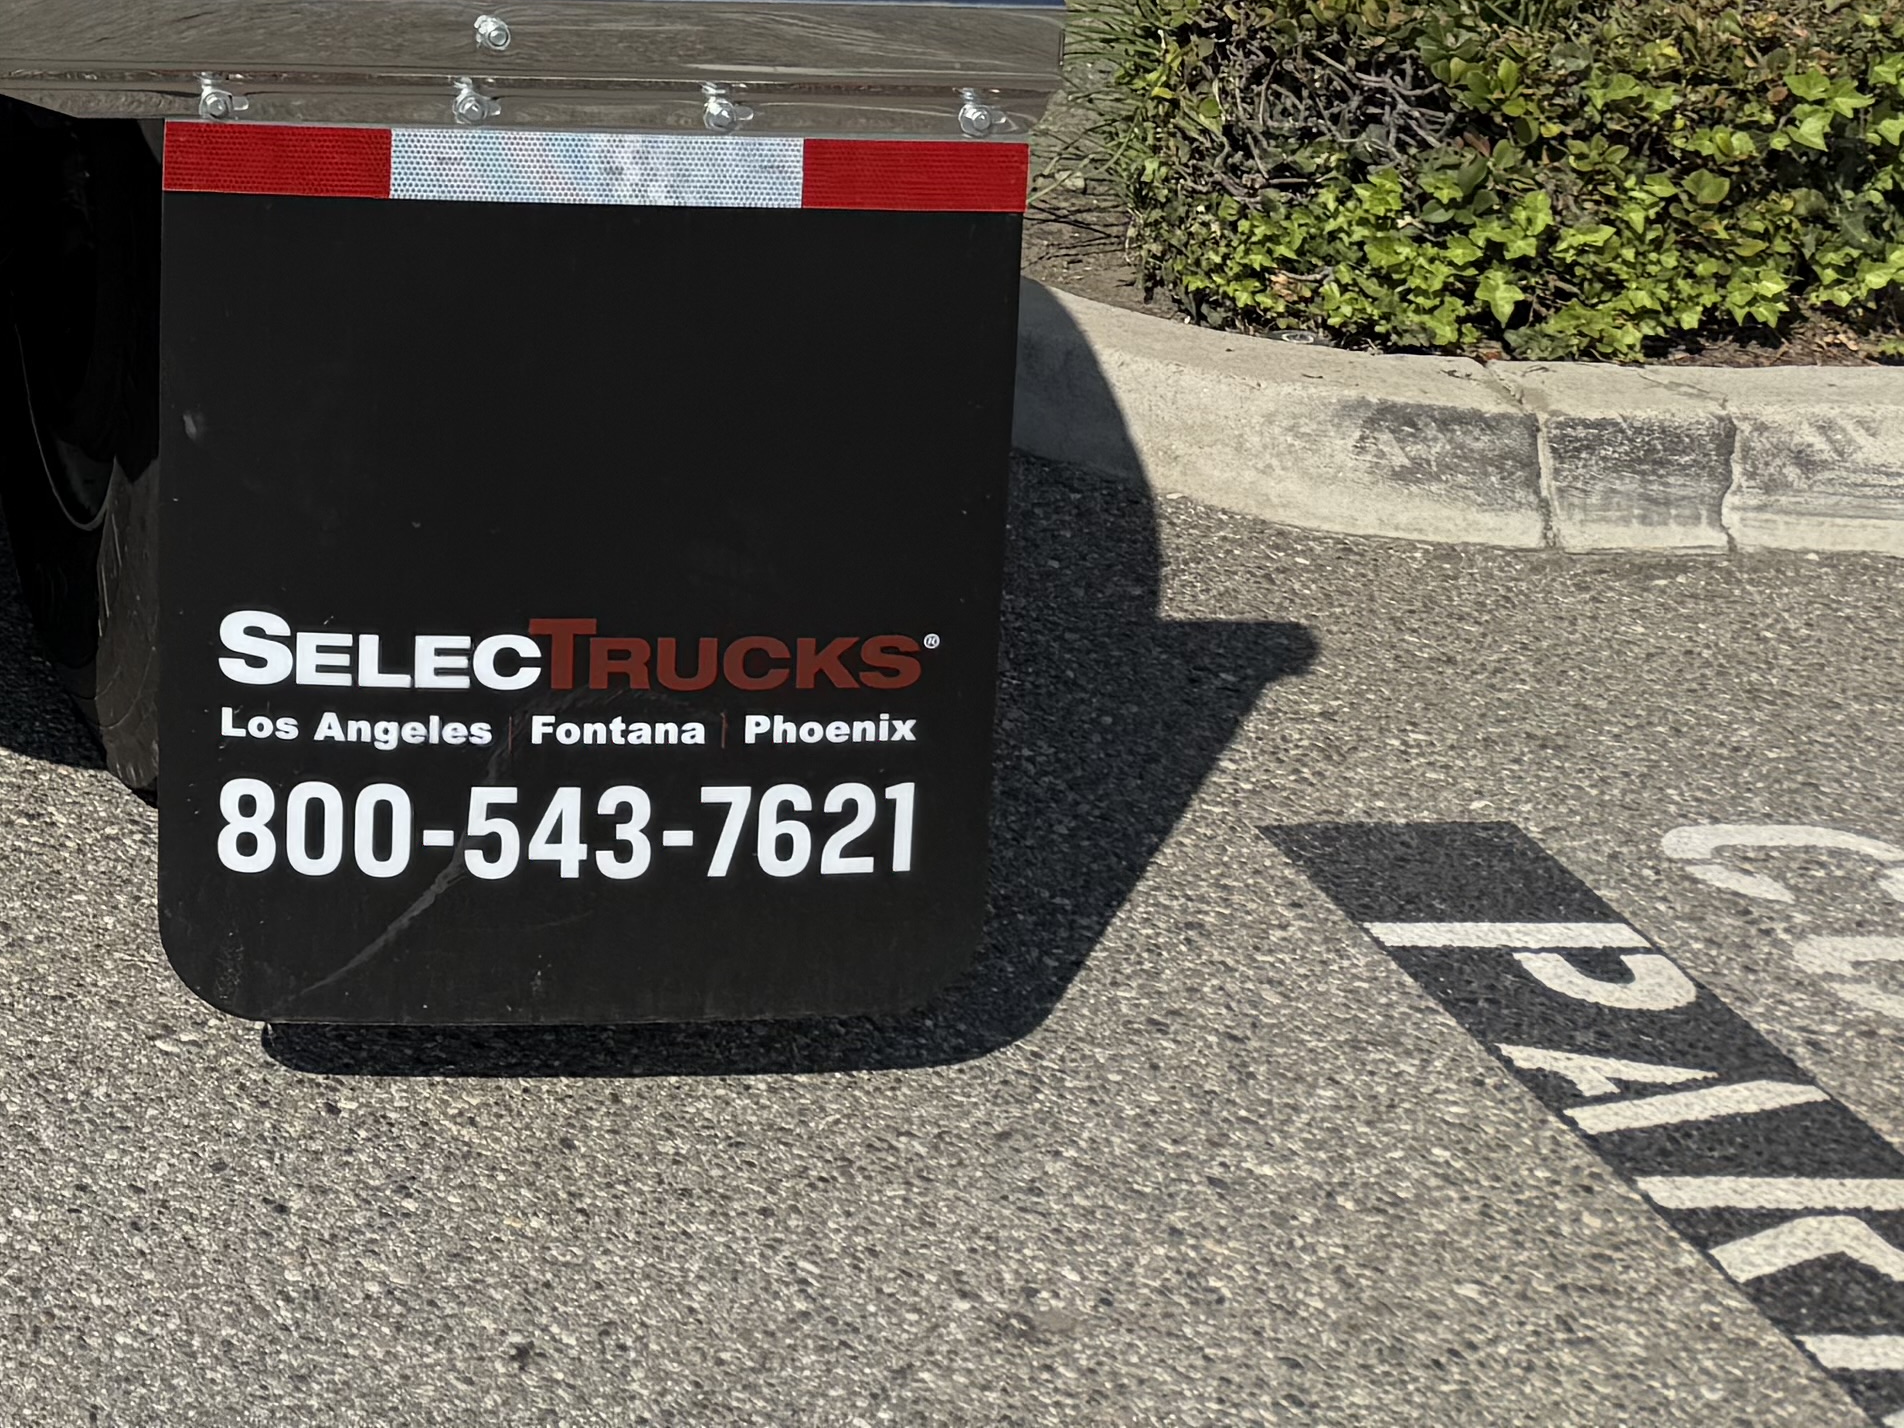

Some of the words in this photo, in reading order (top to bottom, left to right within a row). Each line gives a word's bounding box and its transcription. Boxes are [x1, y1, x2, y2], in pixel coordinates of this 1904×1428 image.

[222, 707, 298, 739] Los
[314, 712, 492, 750] Angeles
[532, 716, 705, 744] Fontana
[745, 714, 916, 743] Phoenix
[218, 778, 915, 879] 800-543-7621
